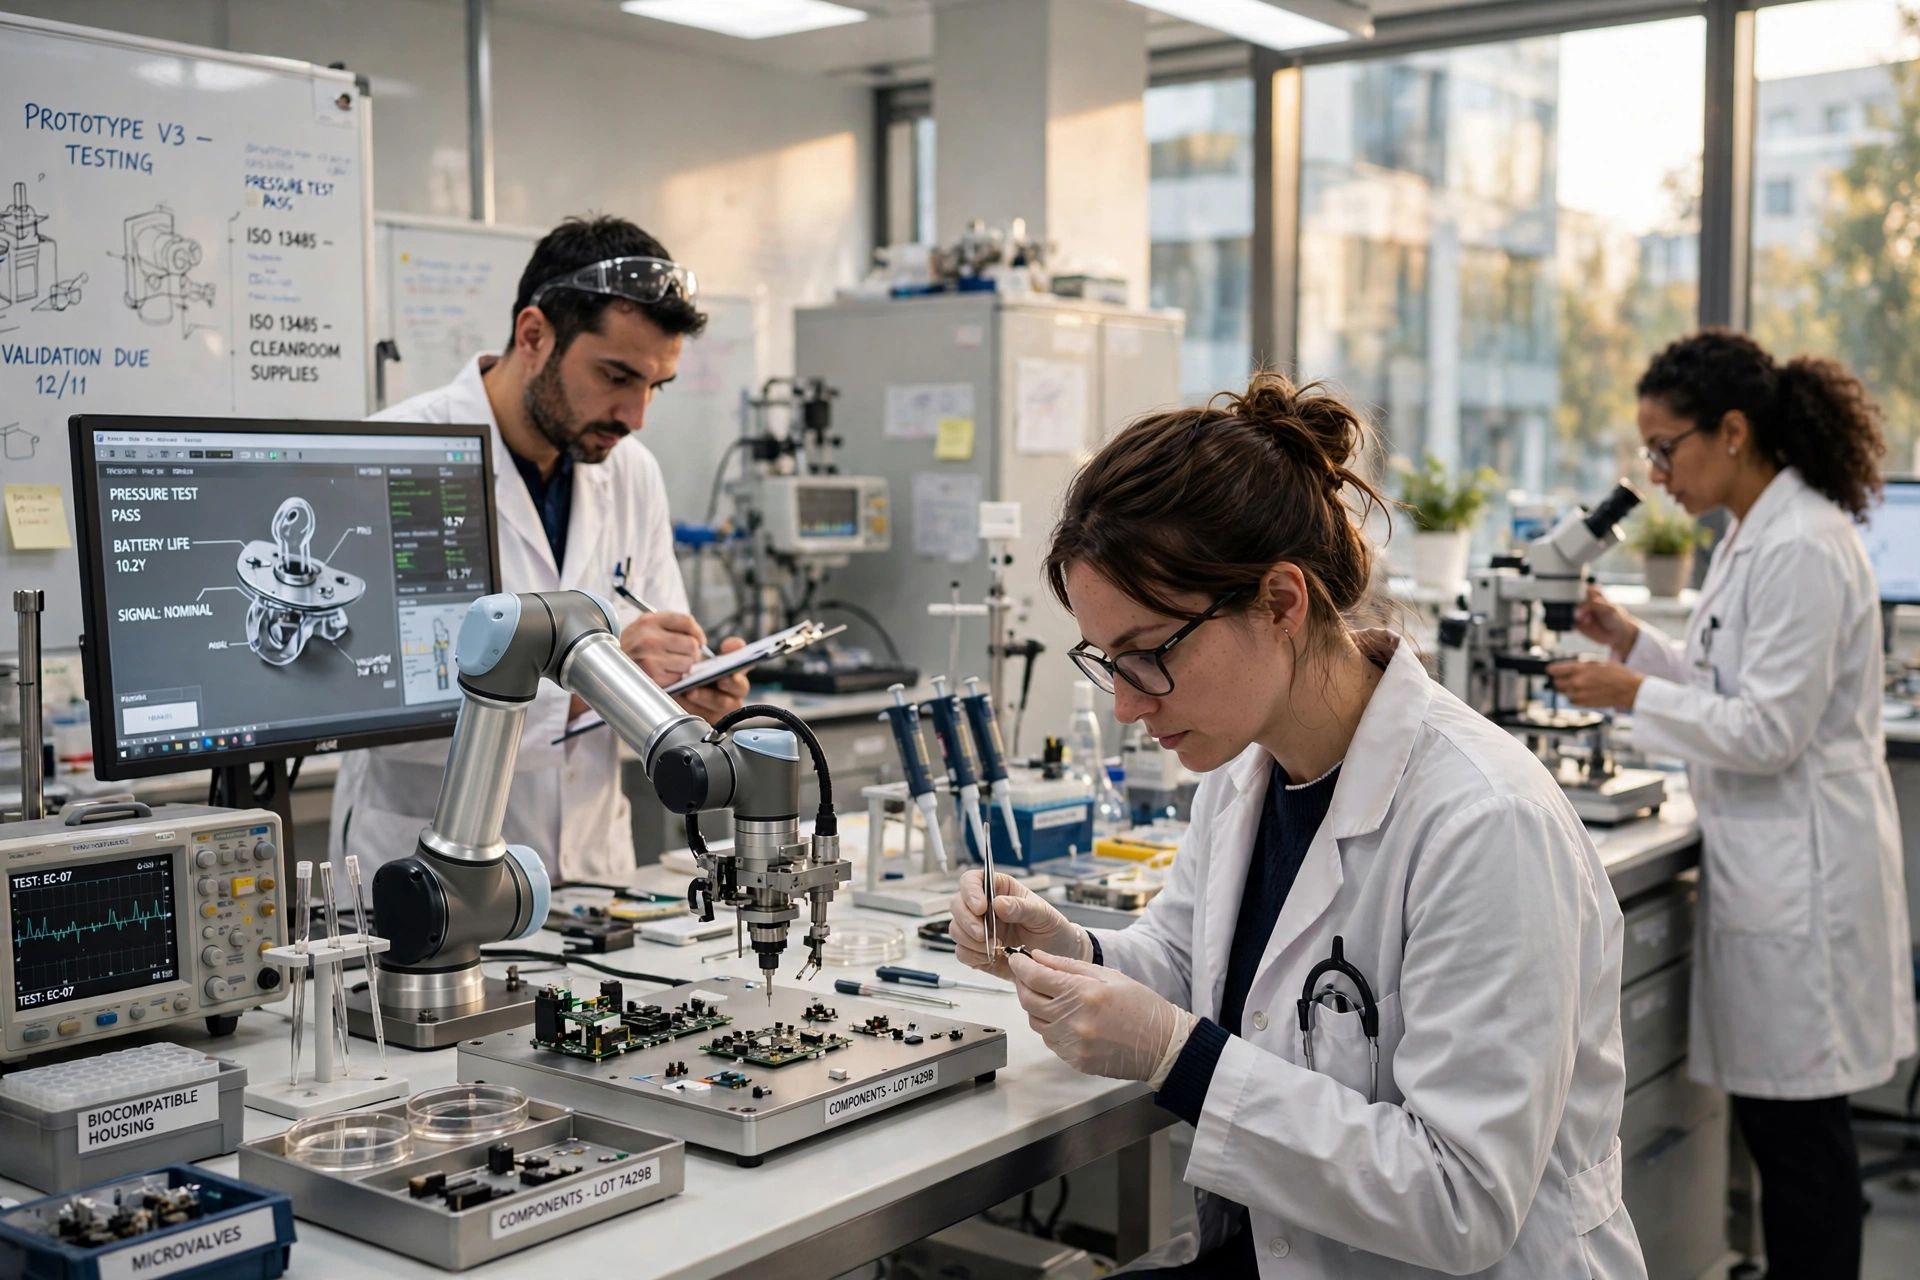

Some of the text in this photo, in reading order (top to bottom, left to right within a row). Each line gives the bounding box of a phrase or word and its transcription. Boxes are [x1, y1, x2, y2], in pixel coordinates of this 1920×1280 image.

[25, 103, 144, 141] PROTOTYPE
[157, 122, 186, 146] V3
[65, 144, 153, 175] TESTING
[307, 181, 335, 196] TEST
[247, 227, 272, 245] ISO
[279, 230, 317, 249] 13485
[250, 314, 274, 331] ISO
[280, 315, 318, 333] 13485
[2, 344, 150, 368] VALIDATION DUE
[250, 340, 341, 360] CLEANROOM
[251, 364, 320, 382] SUPPLIES
[35, 370, 87, 399] 12/11
[110, 487, 198, 501] PRESSURE TEST
[111, 509, 142, 522] PASS
[114, 537, 190, 553] BATTERY LIFE
[115, 559, 147, 573] 10.2Y
[117, 603, 213, 622] SIGNAL: NOMINAL
[13, 871, 73, 889] TEST: EC-07
[18, 986, 75, 1006] TEST: EC-07
[829, 1085, 887, 1115] COMPONENTS
[893, 1077, 909, 1093] LOT
[910, 1069, 934, 1088] 7429B
[88, 1090, 198, 1127] BIOCOMPATIBLE
[89, 1118, 155, 1144] HOUSING
[499, 1188, 584, 1229] COMPONENTS
[594, 1179, 616, 1197] LOT
[618, 1166, 652, 1189] 7429B
[132, 1226, 242, 1271] MICROVALVES
